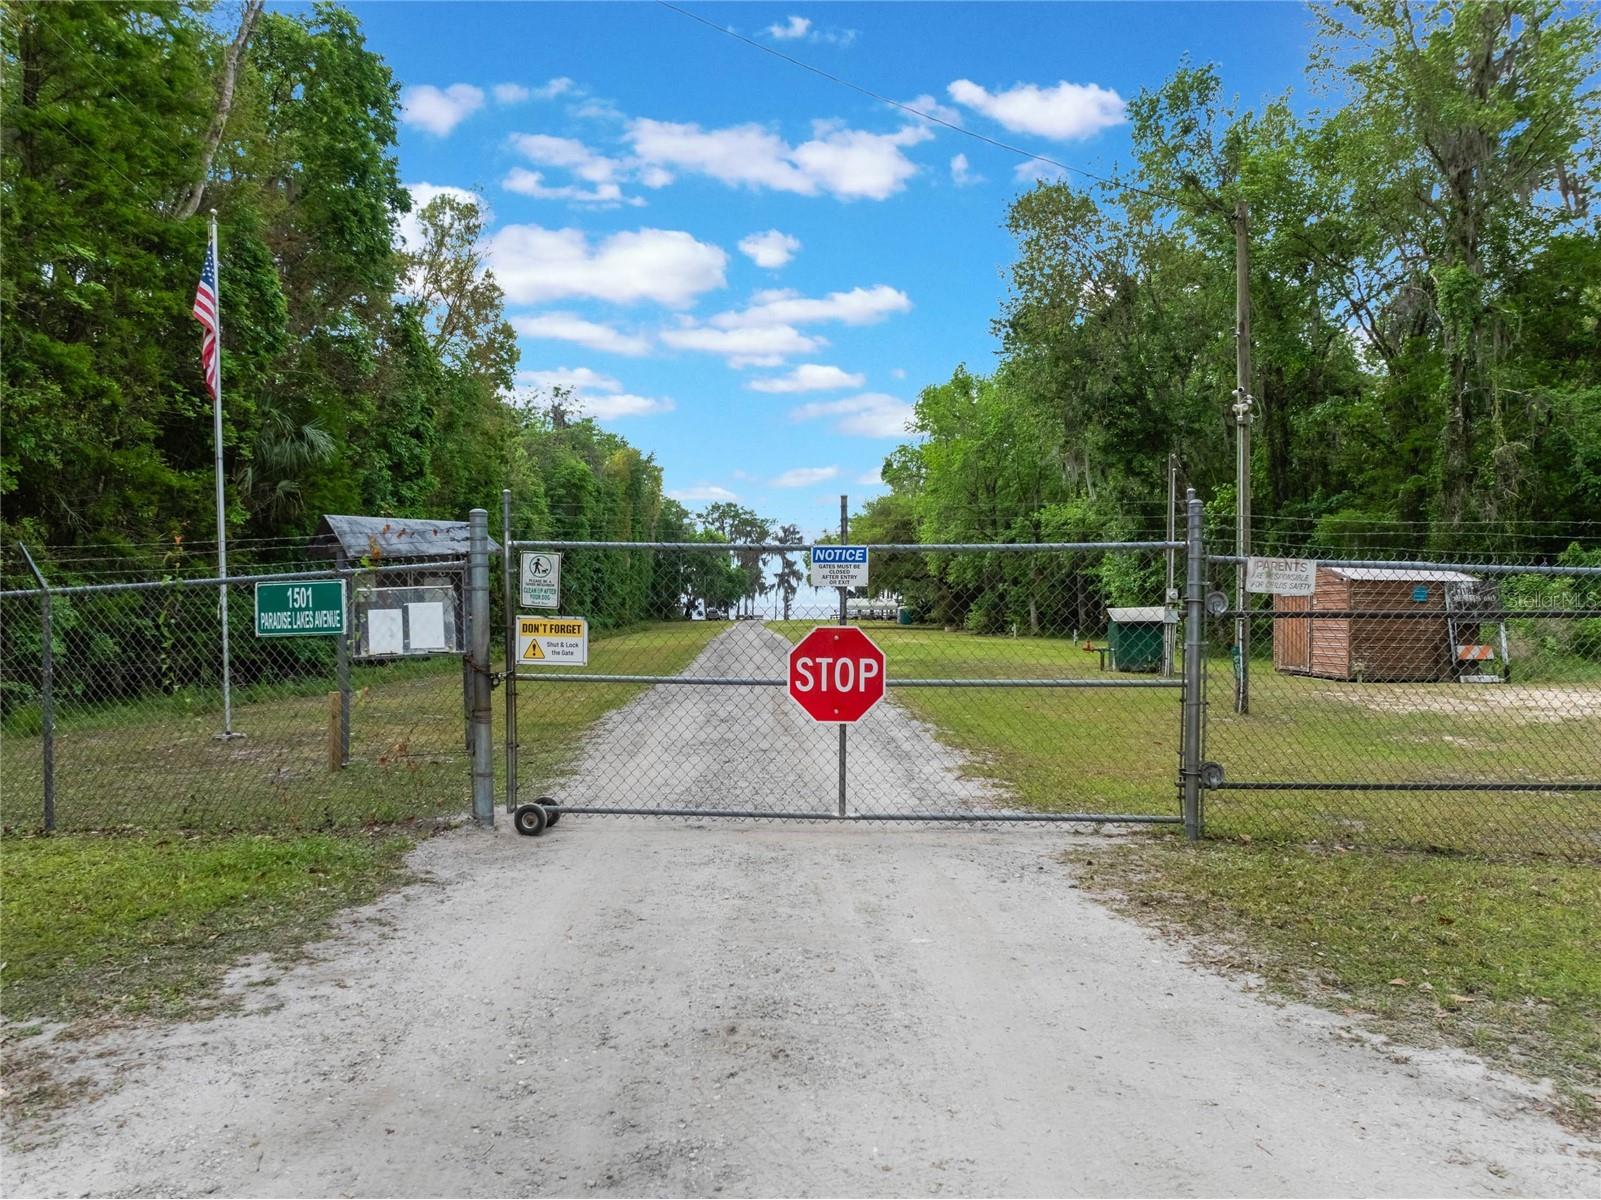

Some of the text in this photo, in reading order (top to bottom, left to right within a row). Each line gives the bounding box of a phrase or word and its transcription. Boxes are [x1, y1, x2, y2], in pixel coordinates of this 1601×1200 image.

[815, 550, 864, 561] NOTICE
[1256, 560, 1308, 572] PARENTS
[287, 587, 312, 608] 1501
[260, 610, 341, 629] PARADISE LAKES AVENUE
[522, 623, 582, 634] DON'T FORGET
[795, 656, 878, 693] STOP
